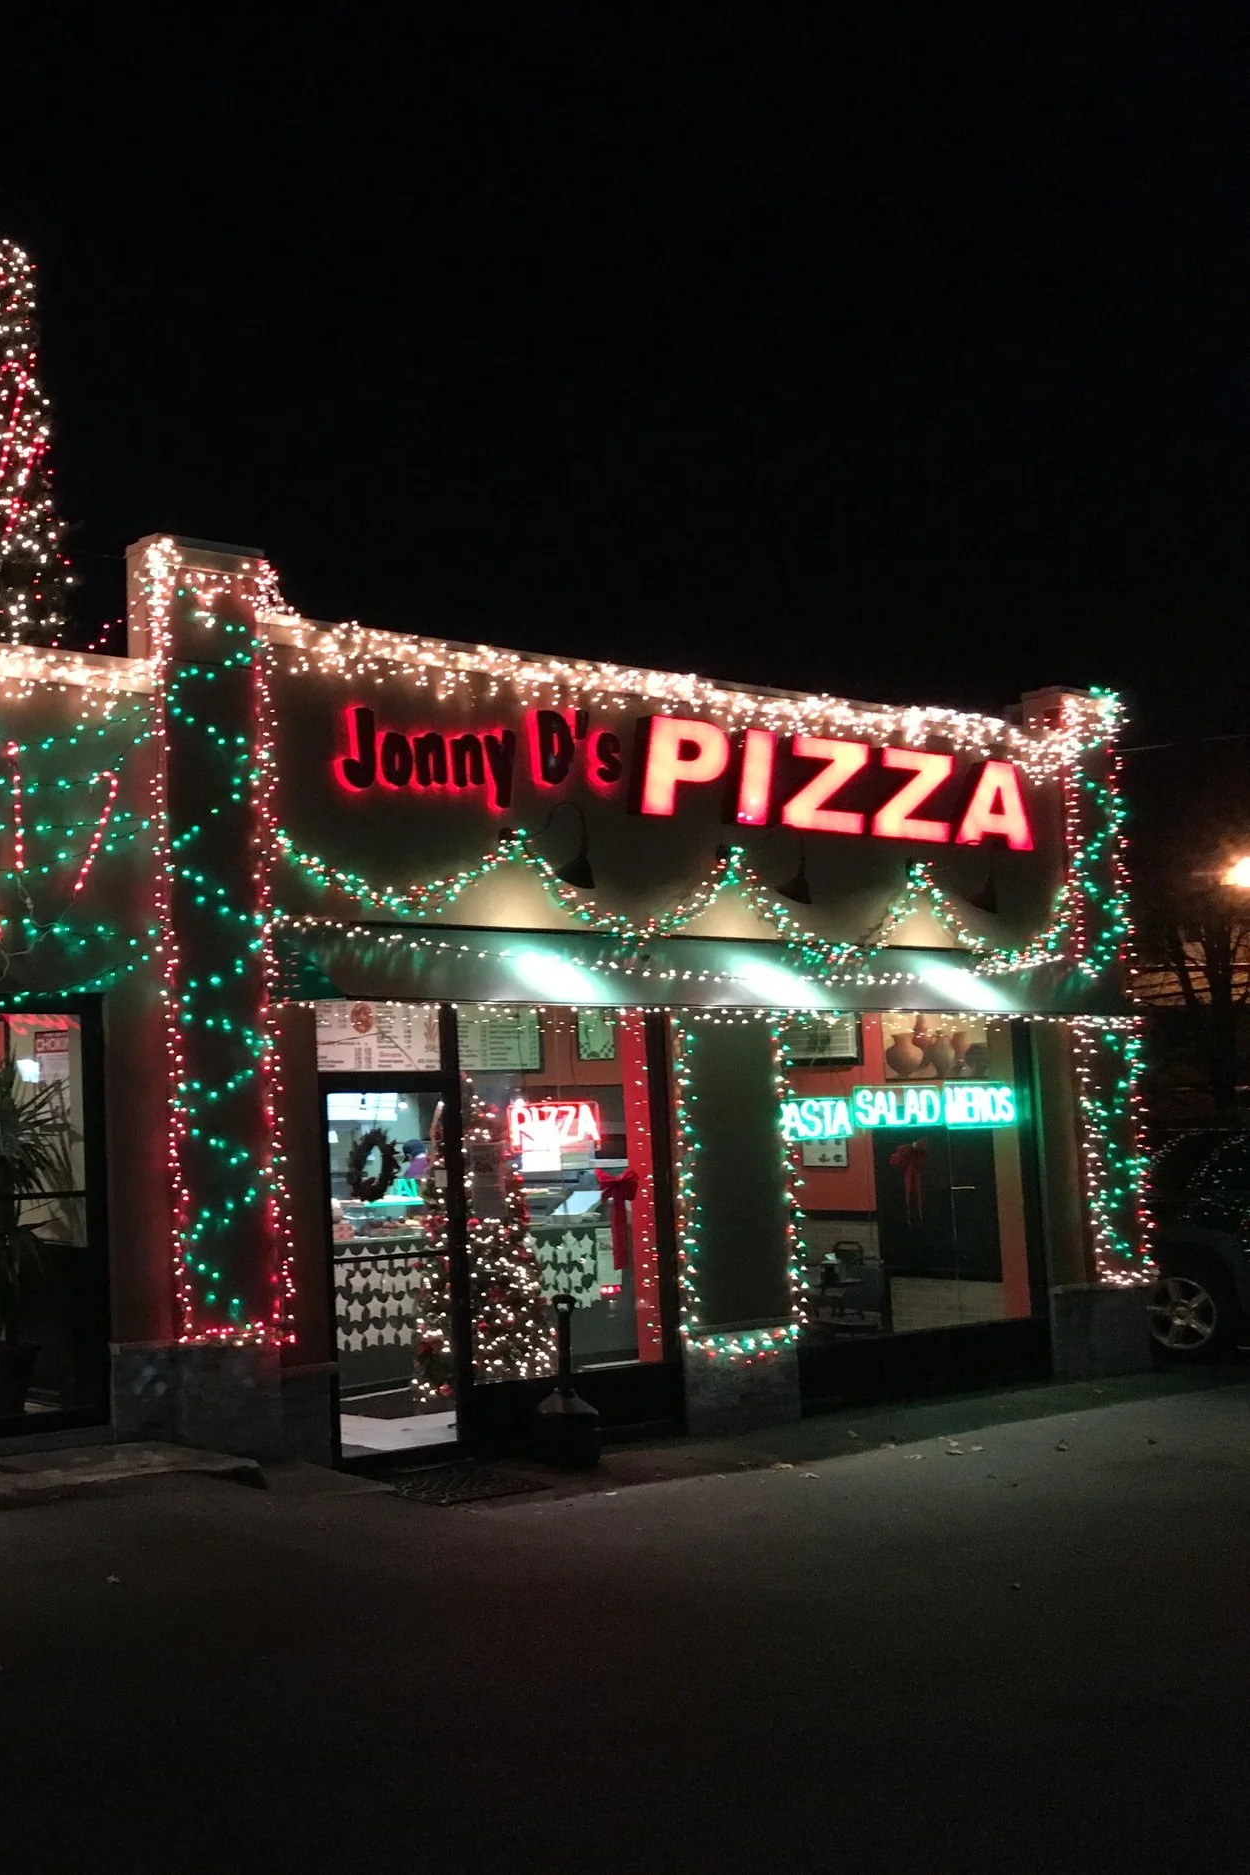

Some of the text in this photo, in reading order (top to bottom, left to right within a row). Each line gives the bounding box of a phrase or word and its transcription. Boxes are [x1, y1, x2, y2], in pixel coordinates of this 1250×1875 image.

[337, 706, 1034, 852] Jonny D's PIZZA
[510, 1102, 601, 1147] PIZZA
[854, 1088, 940, 1126] SALAD
